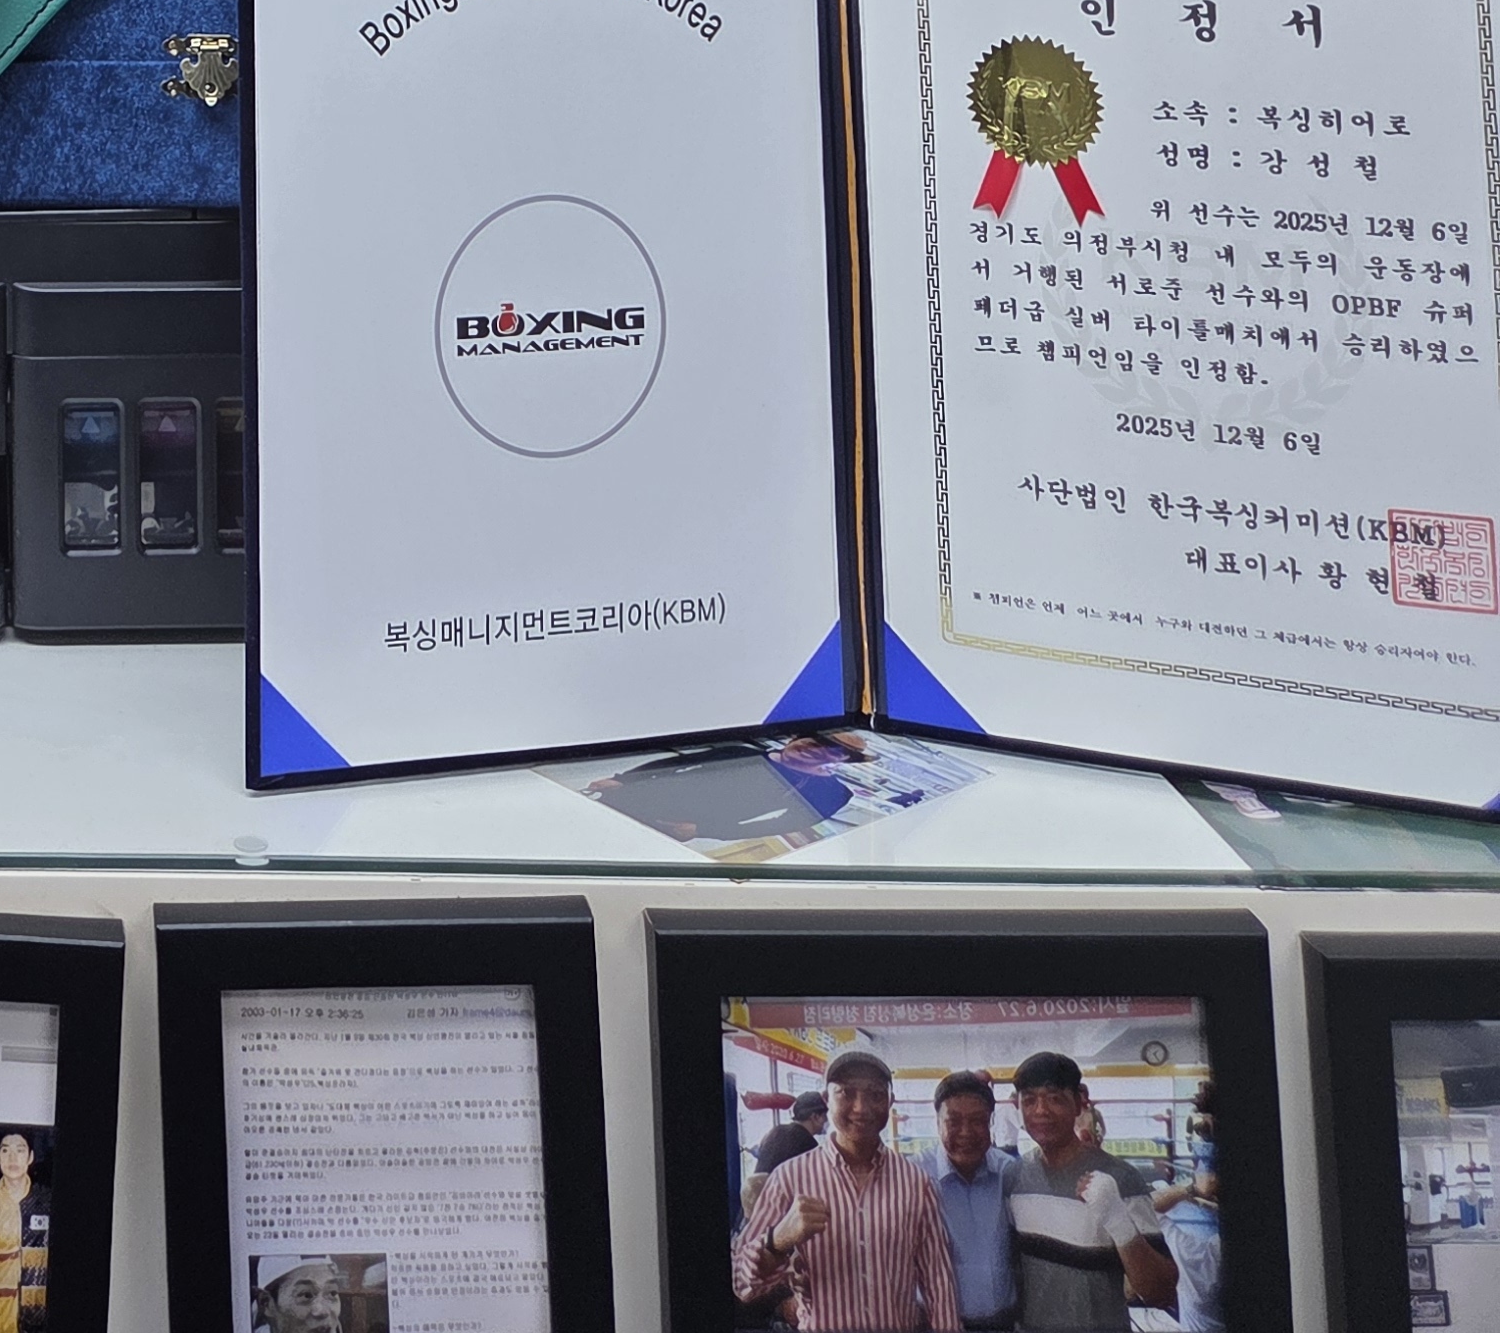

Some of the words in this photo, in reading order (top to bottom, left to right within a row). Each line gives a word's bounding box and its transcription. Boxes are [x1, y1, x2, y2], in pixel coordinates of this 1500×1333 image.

[1179, 0, 1217, 43] 정
[1282, 4, 1322, 49] 서
[1152, 100, 1209, 127] 소속
[1257, 105, 1411, 137] 복싱히어로
[1156, 141, 1210, 170] 성명
[1150, 199, 1170, 222] 위
[1188, 201, 1260, 228] 선수는
[1273, 210, 1349, 237] 2025년
[1364, 216, 1415, 242] 12월
[1431, 221, 1469, 245] 6일
[969, 220, 1042, 246] 경기도
[1062, 229, 1189, 264] 의정부시청
[1214, 244, 1235, 268] 내
[1260, 249, 1338, 277] 모두의
[1363, 255, 1471, 287] 운동장에
[971, 258, 991, 281] 서
[1012, 261, 1084, 291] 거행된
[1106, 272, 1184, 302] 서로준
[1204, 281, 1309, 313] 선수와의
[1331, 294, 1402, 318] OPBF
[1422, 300, 1474, 327] 슈퍼
[456, 307, 646, 340] BOXING
[456, 334, 646, 357] MANAGEMENT
[1064, 305, 1111, 332] 실버
[1341, 332, 1480, 365] 승리하였으
[974, 334, 1022, 356] 므로
[1037, 339, 1164, 376] 챔피언임을
[1180, 356, 1269, 385] 인정함.
[1115, 412, 1196, 442] 2025년
[1213, 422, 1265, 450] 12월
[1283, 426, 1321, 456] 6일
[1016, 473, 1127, 514] 사단법인
[1147, 491, 1447, 551] 한국복싱커미션(KBM)
[1184, 545, 1302, 585] 대표이사
[1317, 561, 1348, 590] 황
[384, 591, 727, 653] 복싱매니지먼트코리아(KBM)
